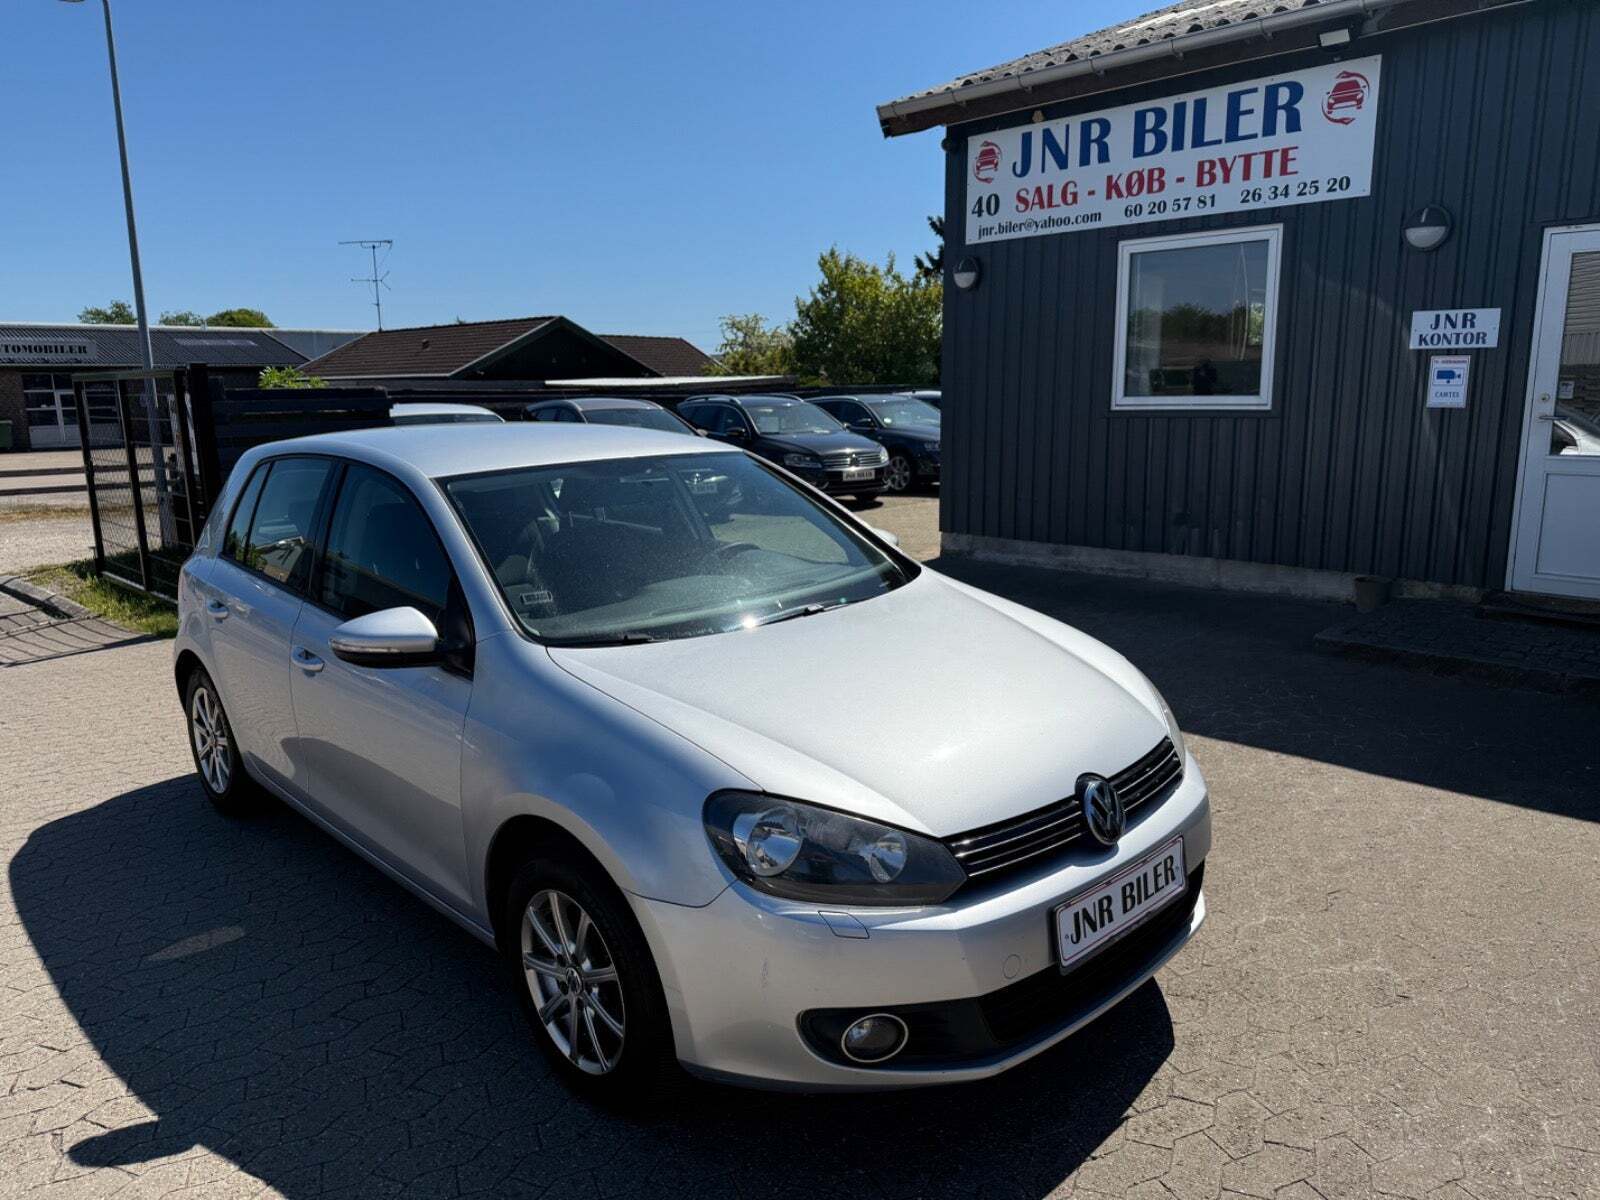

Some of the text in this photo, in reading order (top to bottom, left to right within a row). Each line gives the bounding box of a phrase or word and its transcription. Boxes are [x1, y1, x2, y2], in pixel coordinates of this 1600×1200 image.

[1012, 81, 1304, 178] JNR BILER
[1015, 180, 1079, 213] SALG
[1105, 167, 1166, 200] KØB
[1196, 146, 1299, 187] BYTTE
[1240, 175, 1351, 204] 26 34 25 20
[971, 193, 1001, 218] 40
[1124, 194, 1216, 218] 60 20 57 81
[978, 211, 1102, 239] jnr.biler@yahoo.com
[1430, 312, 1477, 330] JNR
[0, 344, 87, 353] TOMOBILER
[1418, 331, 1487, 346] KONTOR
[1070, 855, 1176, 945] JNR BILER
